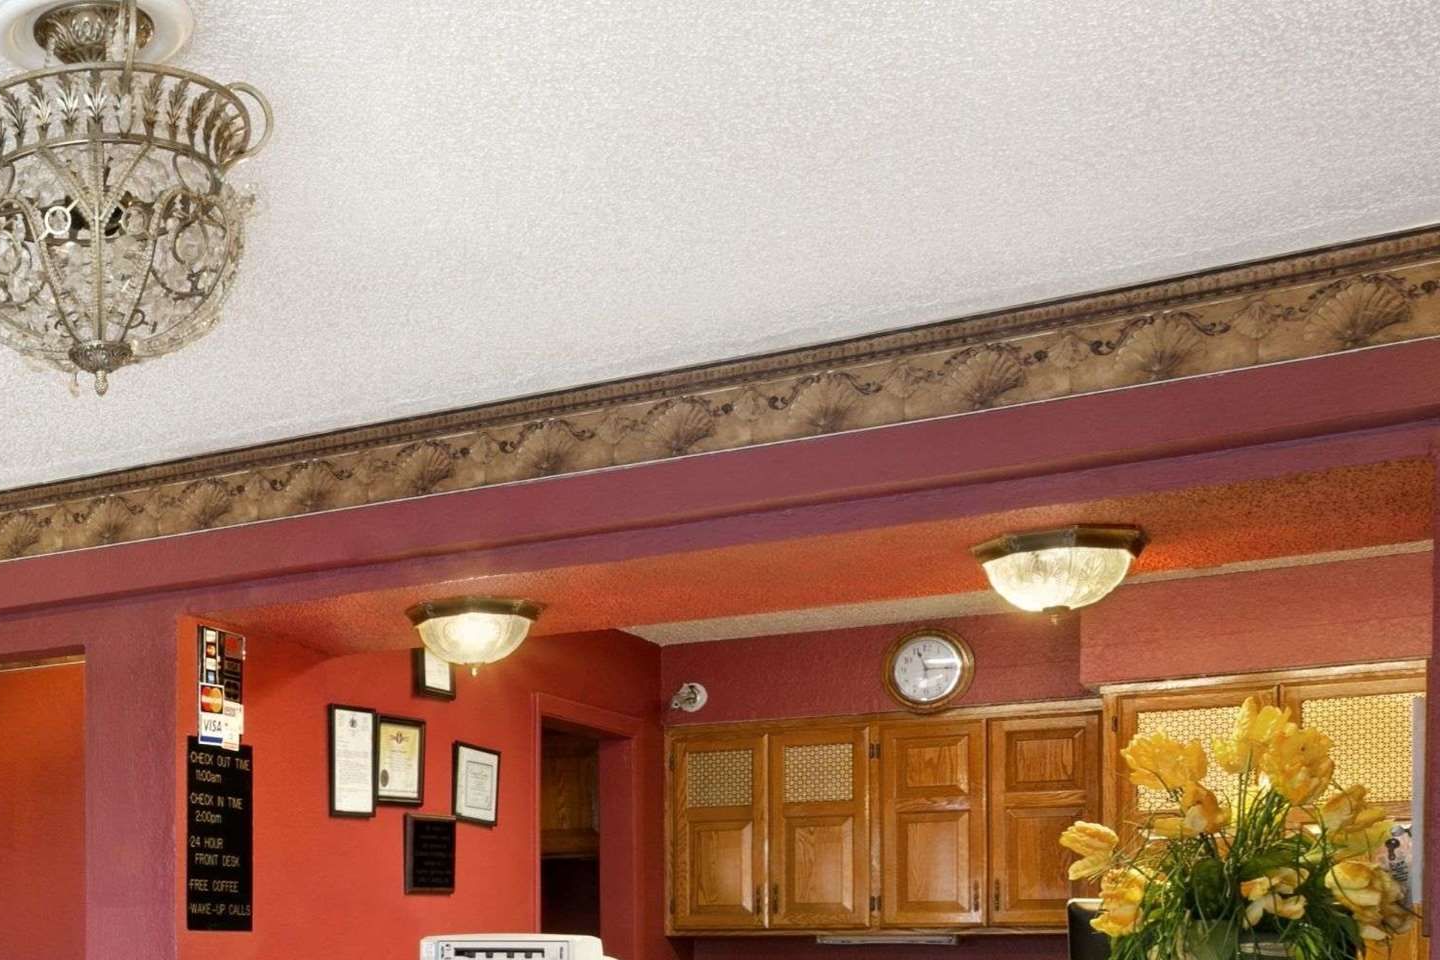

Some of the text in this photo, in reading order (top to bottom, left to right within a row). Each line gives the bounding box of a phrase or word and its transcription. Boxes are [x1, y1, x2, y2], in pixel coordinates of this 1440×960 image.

[203, 719, 222, 732] VISA
[190, 751, 251, 771] CHECK OUT TIME
[190, 792, 243, 810] CHECK IN TIME
[190, 835, 224, 849] 24 HOUR
[195, 852, 240, 868] FRONT DESK
[189, 878, 239, 893] FREE COFFEE
[190, 902, 251, 917] WAKE-UP CALLS
